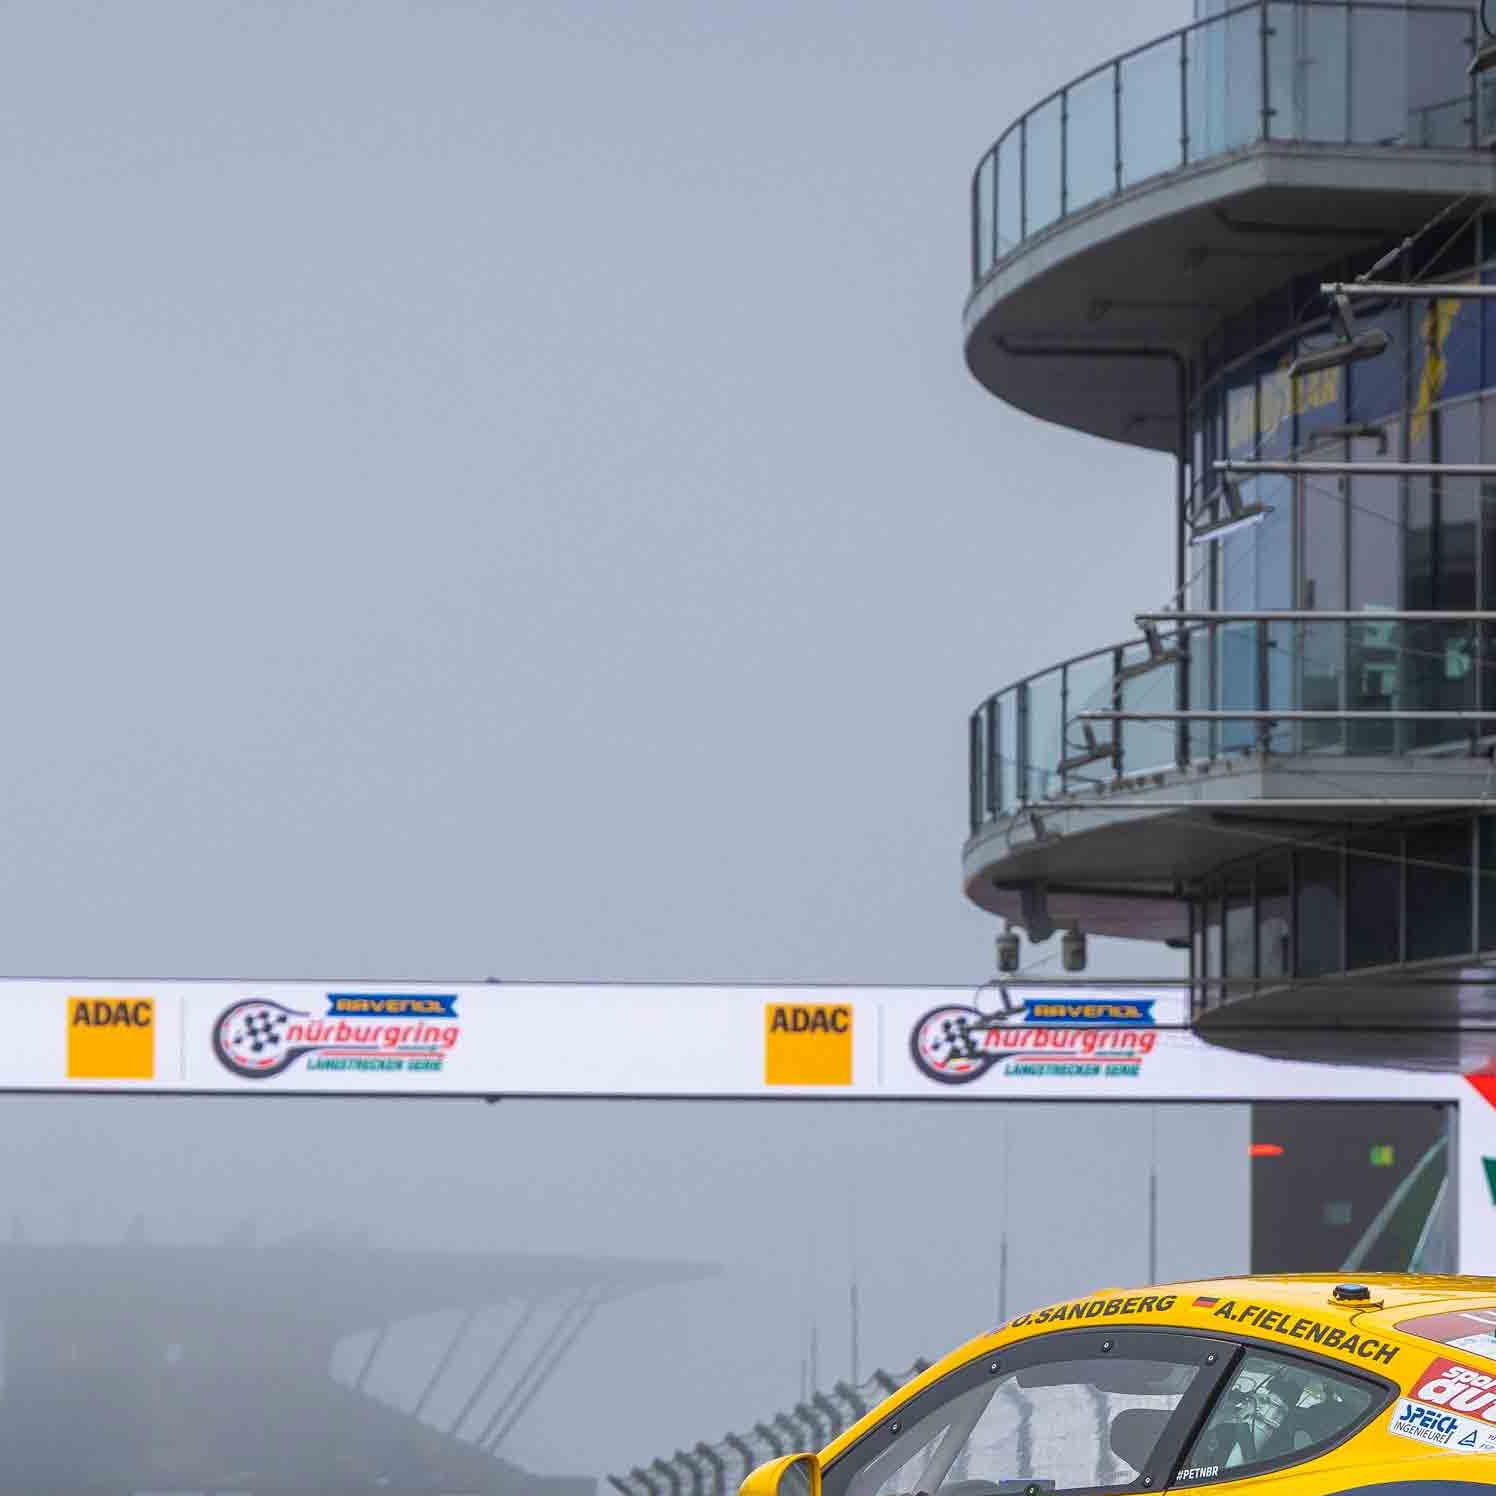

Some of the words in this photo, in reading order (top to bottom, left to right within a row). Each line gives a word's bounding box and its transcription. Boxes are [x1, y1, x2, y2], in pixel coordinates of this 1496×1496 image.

[72, 1002, 152, 1027] ADAC
[335, 999, 446, 1013] RAVENOL
[770, 1007, 849, 1033] ADAC
[286, 1019, 459, 1048] nürburgring
[1215, 1300, 1401, 1365] A.FIELENBACH
